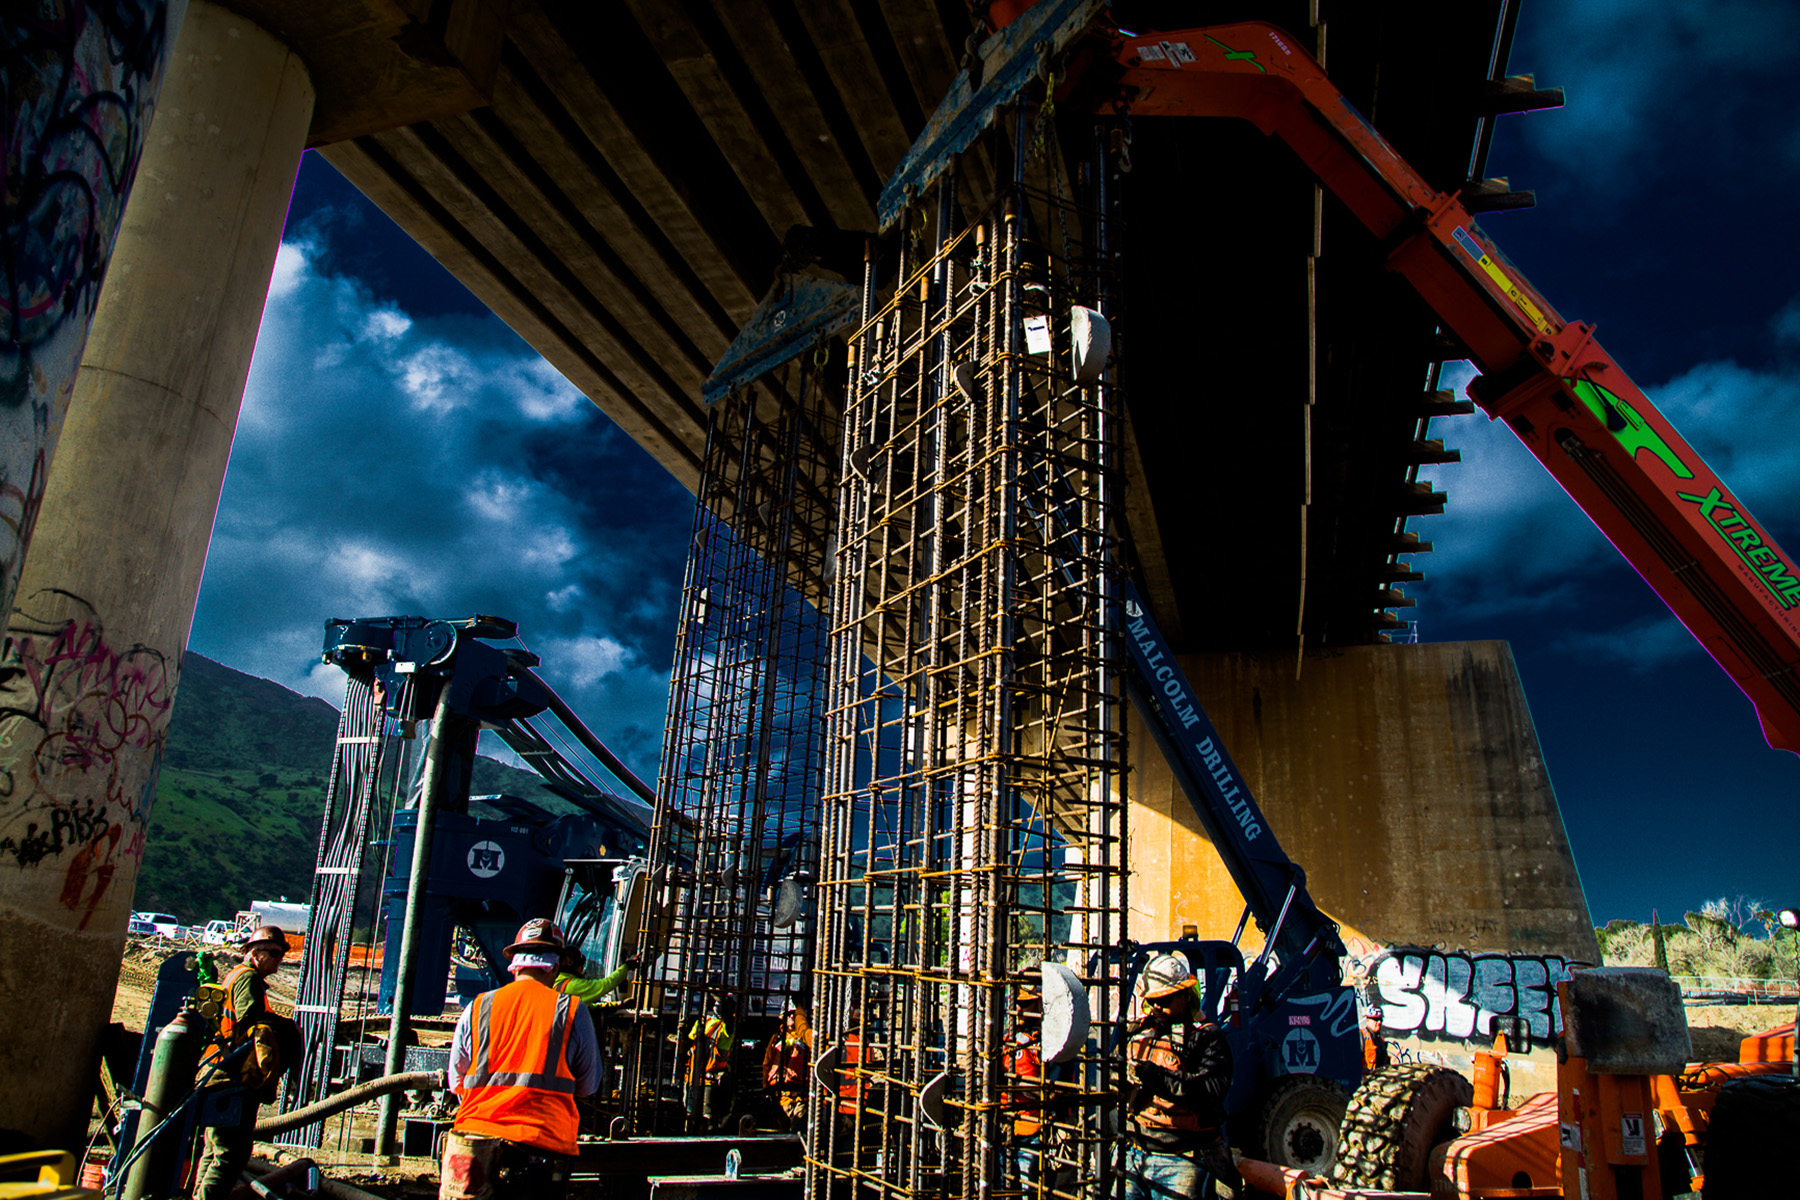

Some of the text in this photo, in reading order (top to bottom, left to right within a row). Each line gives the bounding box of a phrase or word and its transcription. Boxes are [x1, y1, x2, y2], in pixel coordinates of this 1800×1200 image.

[1676, 486, 1800, 611] XTREME
[1128, 617, 1262, 842] MALCOLM DRILLING
